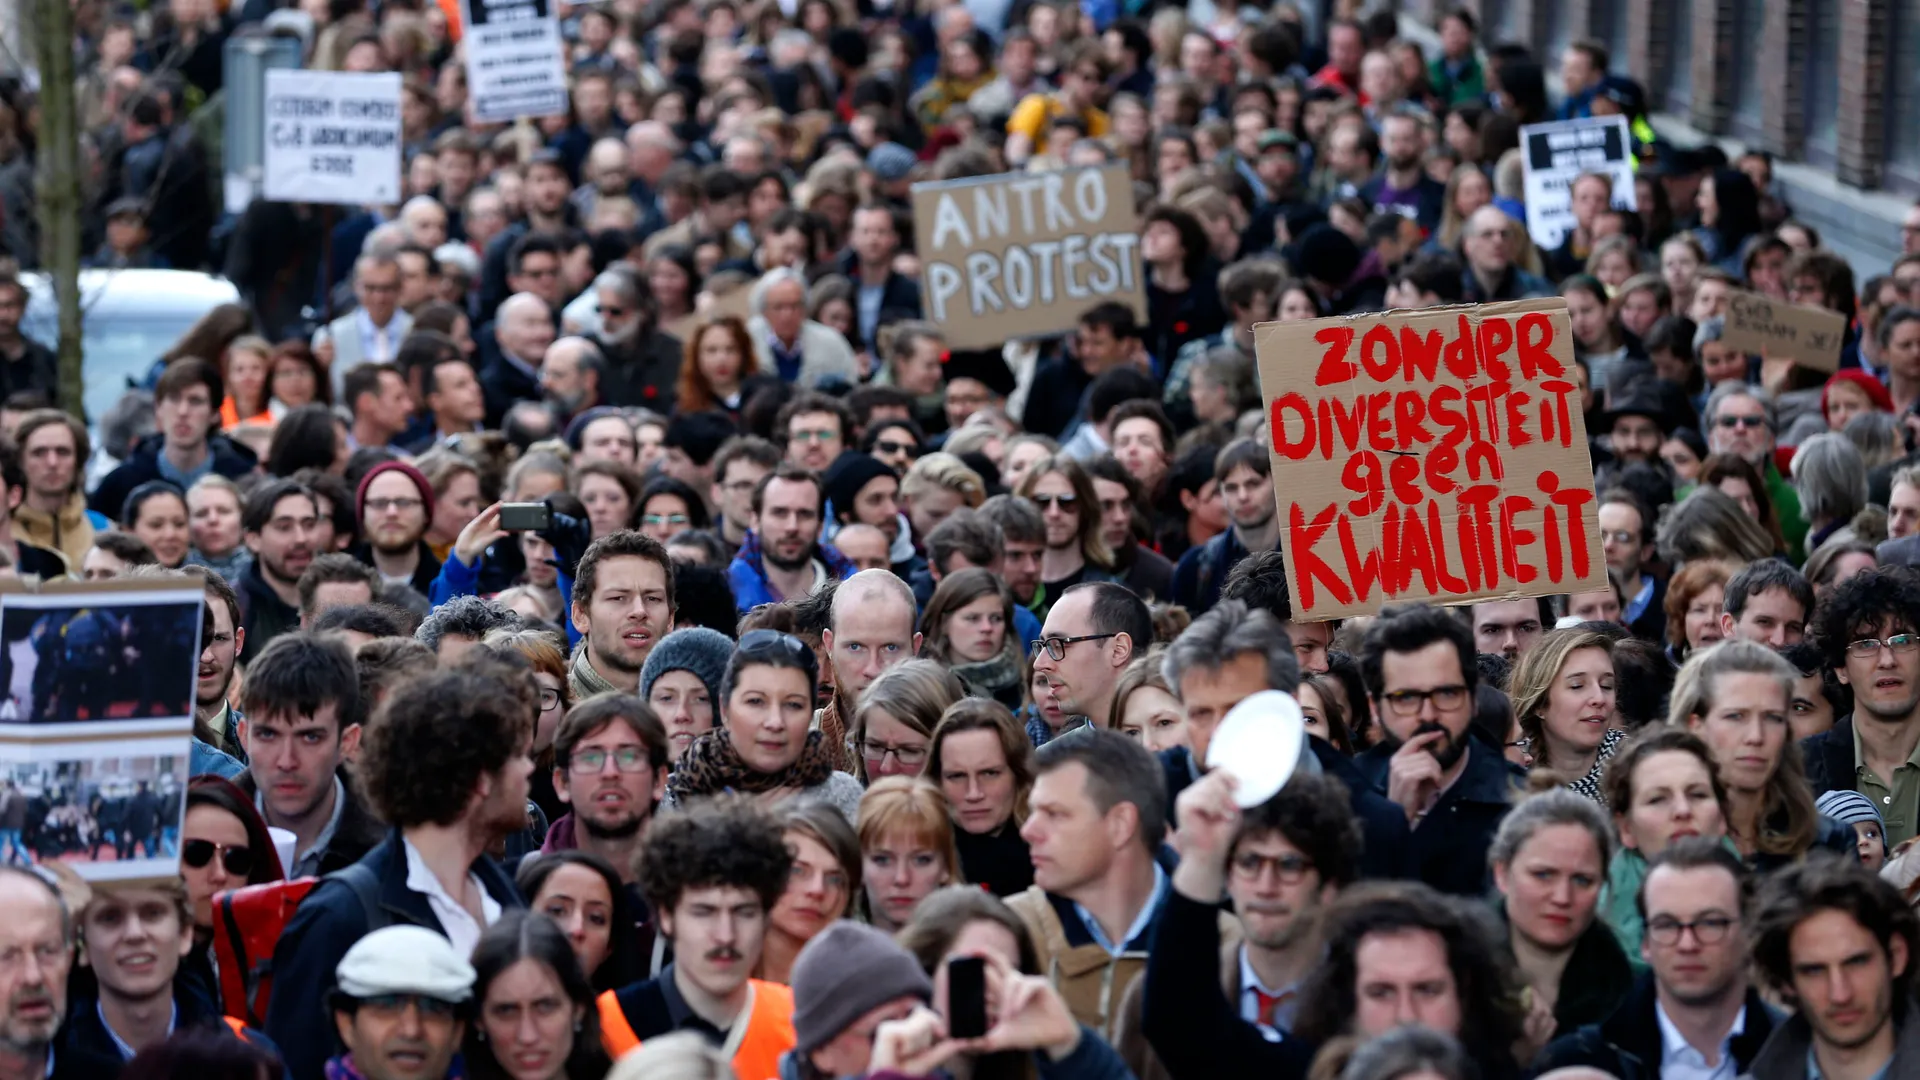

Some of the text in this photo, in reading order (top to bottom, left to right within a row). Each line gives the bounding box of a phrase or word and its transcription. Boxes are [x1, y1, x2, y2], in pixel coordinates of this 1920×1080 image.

[932, 168, 1108, 249] ANTRO
[927, 232, 1139, 324] PROTEST
[1341, 441, 1504, 516] geen
